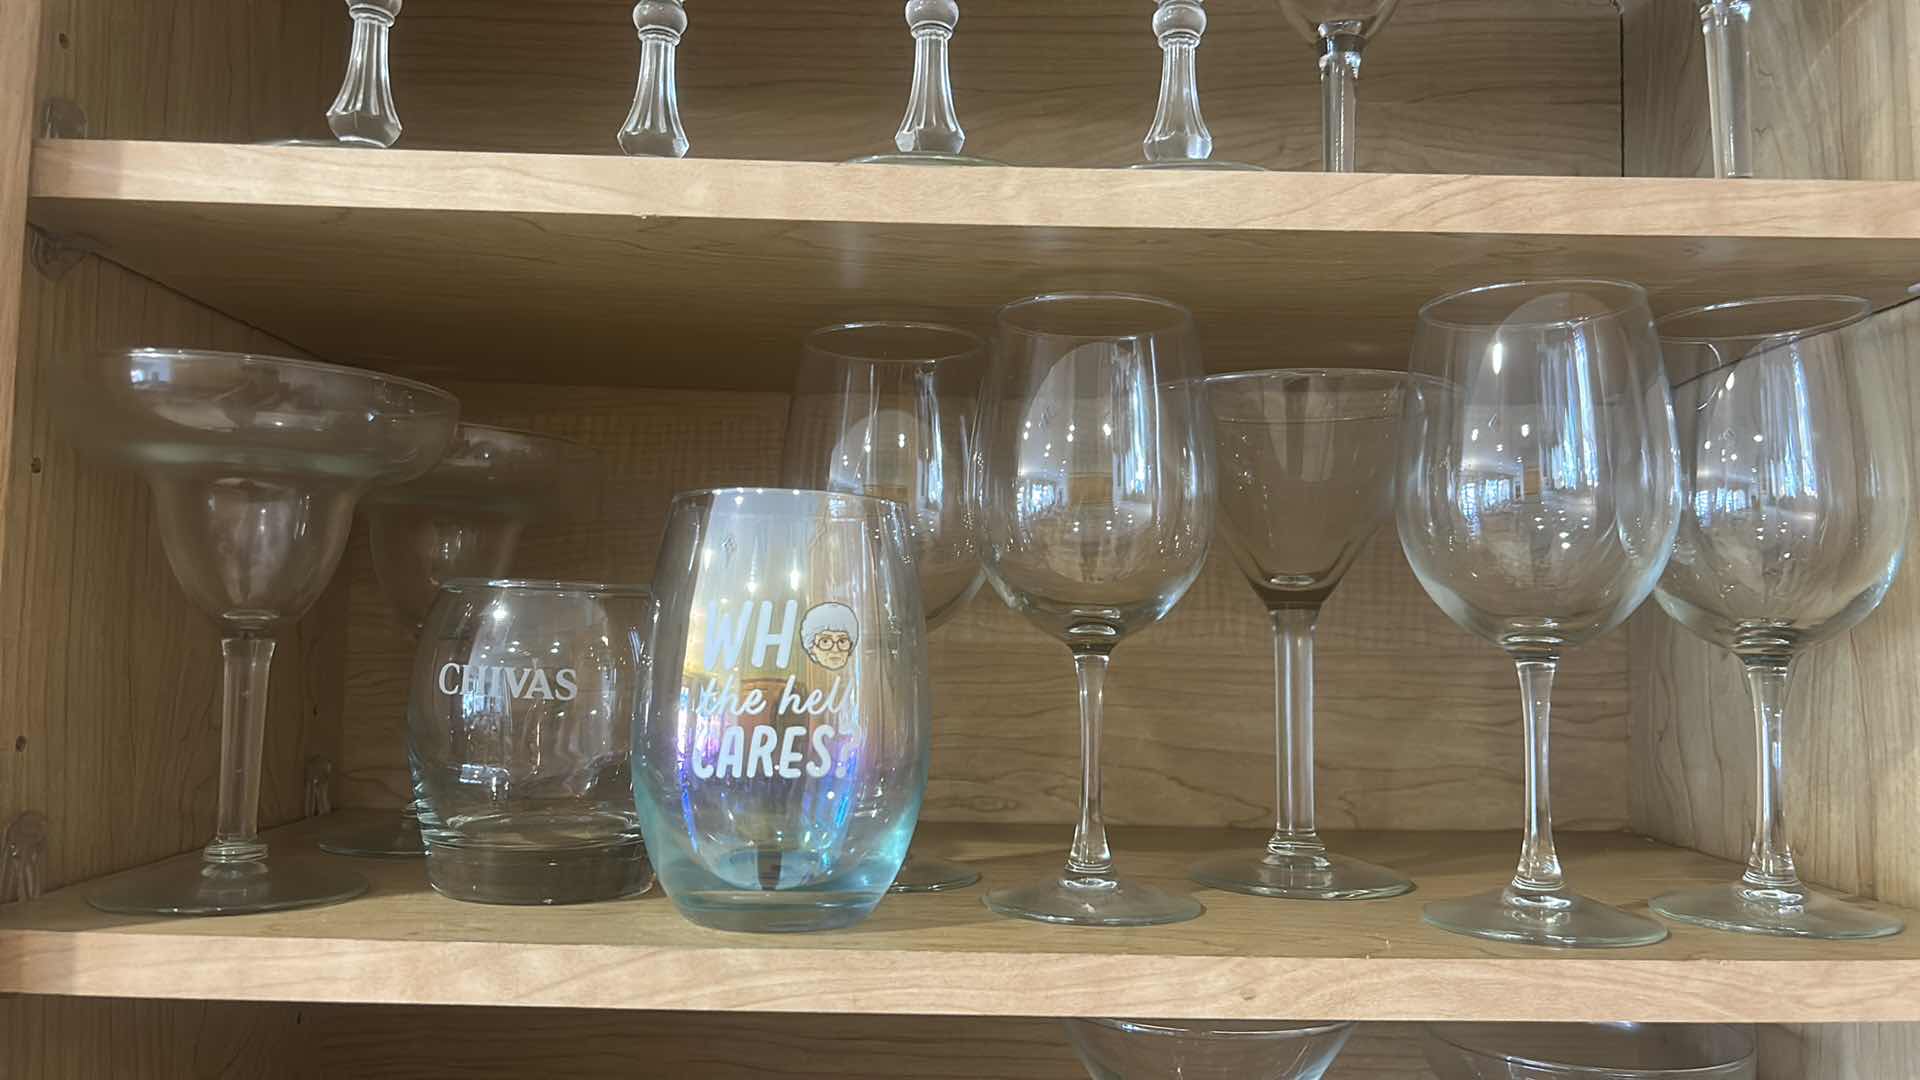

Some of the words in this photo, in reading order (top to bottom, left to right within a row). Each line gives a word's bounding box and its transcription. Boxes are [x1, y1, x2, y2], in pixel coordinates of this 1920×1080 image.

[438, 662, 577, 700] CHIVAS
[697, 675, 767, 717] the
[778, 674, 857, 716] hell
[692, 724, 859, 779] CARES?
